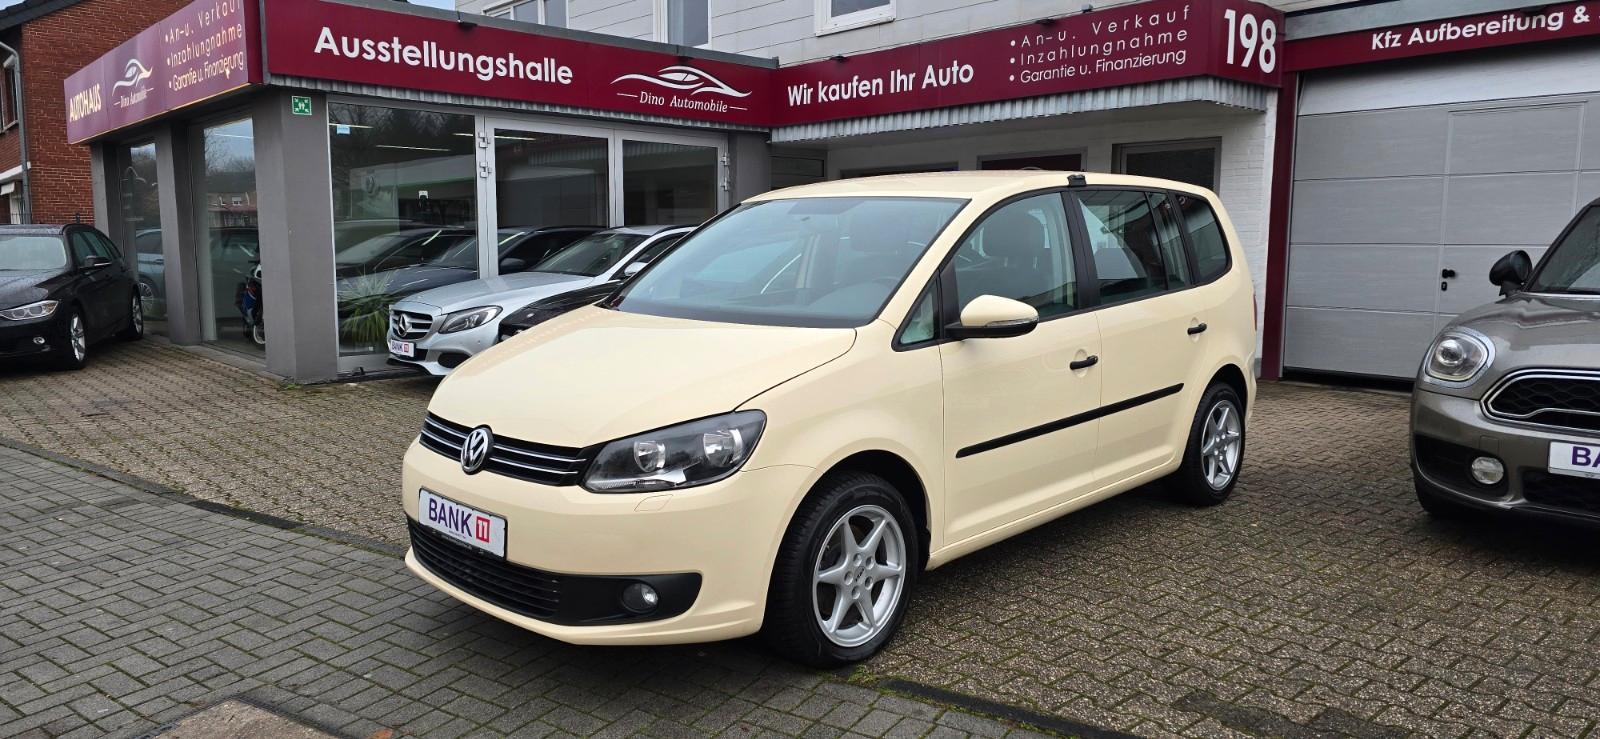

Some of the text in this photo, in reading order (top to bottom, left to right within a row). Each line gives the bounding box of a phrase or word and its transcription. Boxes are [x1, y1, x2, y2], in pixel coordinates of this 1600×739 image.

[1092, 5, 1190, 35] Verkauf
[1371, 5, 1591, 50] Kfz Aufbereitung &
[170, 24, 242, 68] Inzahlungnahme
[314, 26, 574, 84] Ausstellungshalle
[1021, 29, 1188, 66] Inzahlungnahme
[1224, 8, 1277, 73] 198
[173, 67, 197, 91] Garantie
[203, 51, 244, 79] Finanzierung
[787, 60, 974, 107] Wir kaufen Ihr Auto
[1020, 50, 1187, 83] Garantie u. Finanzierung
[70, 83, 102, 122] AUTOHAUS
[639, 91, 729, 113] Dino Automobile
[429, 497, 473, 538] BANK
